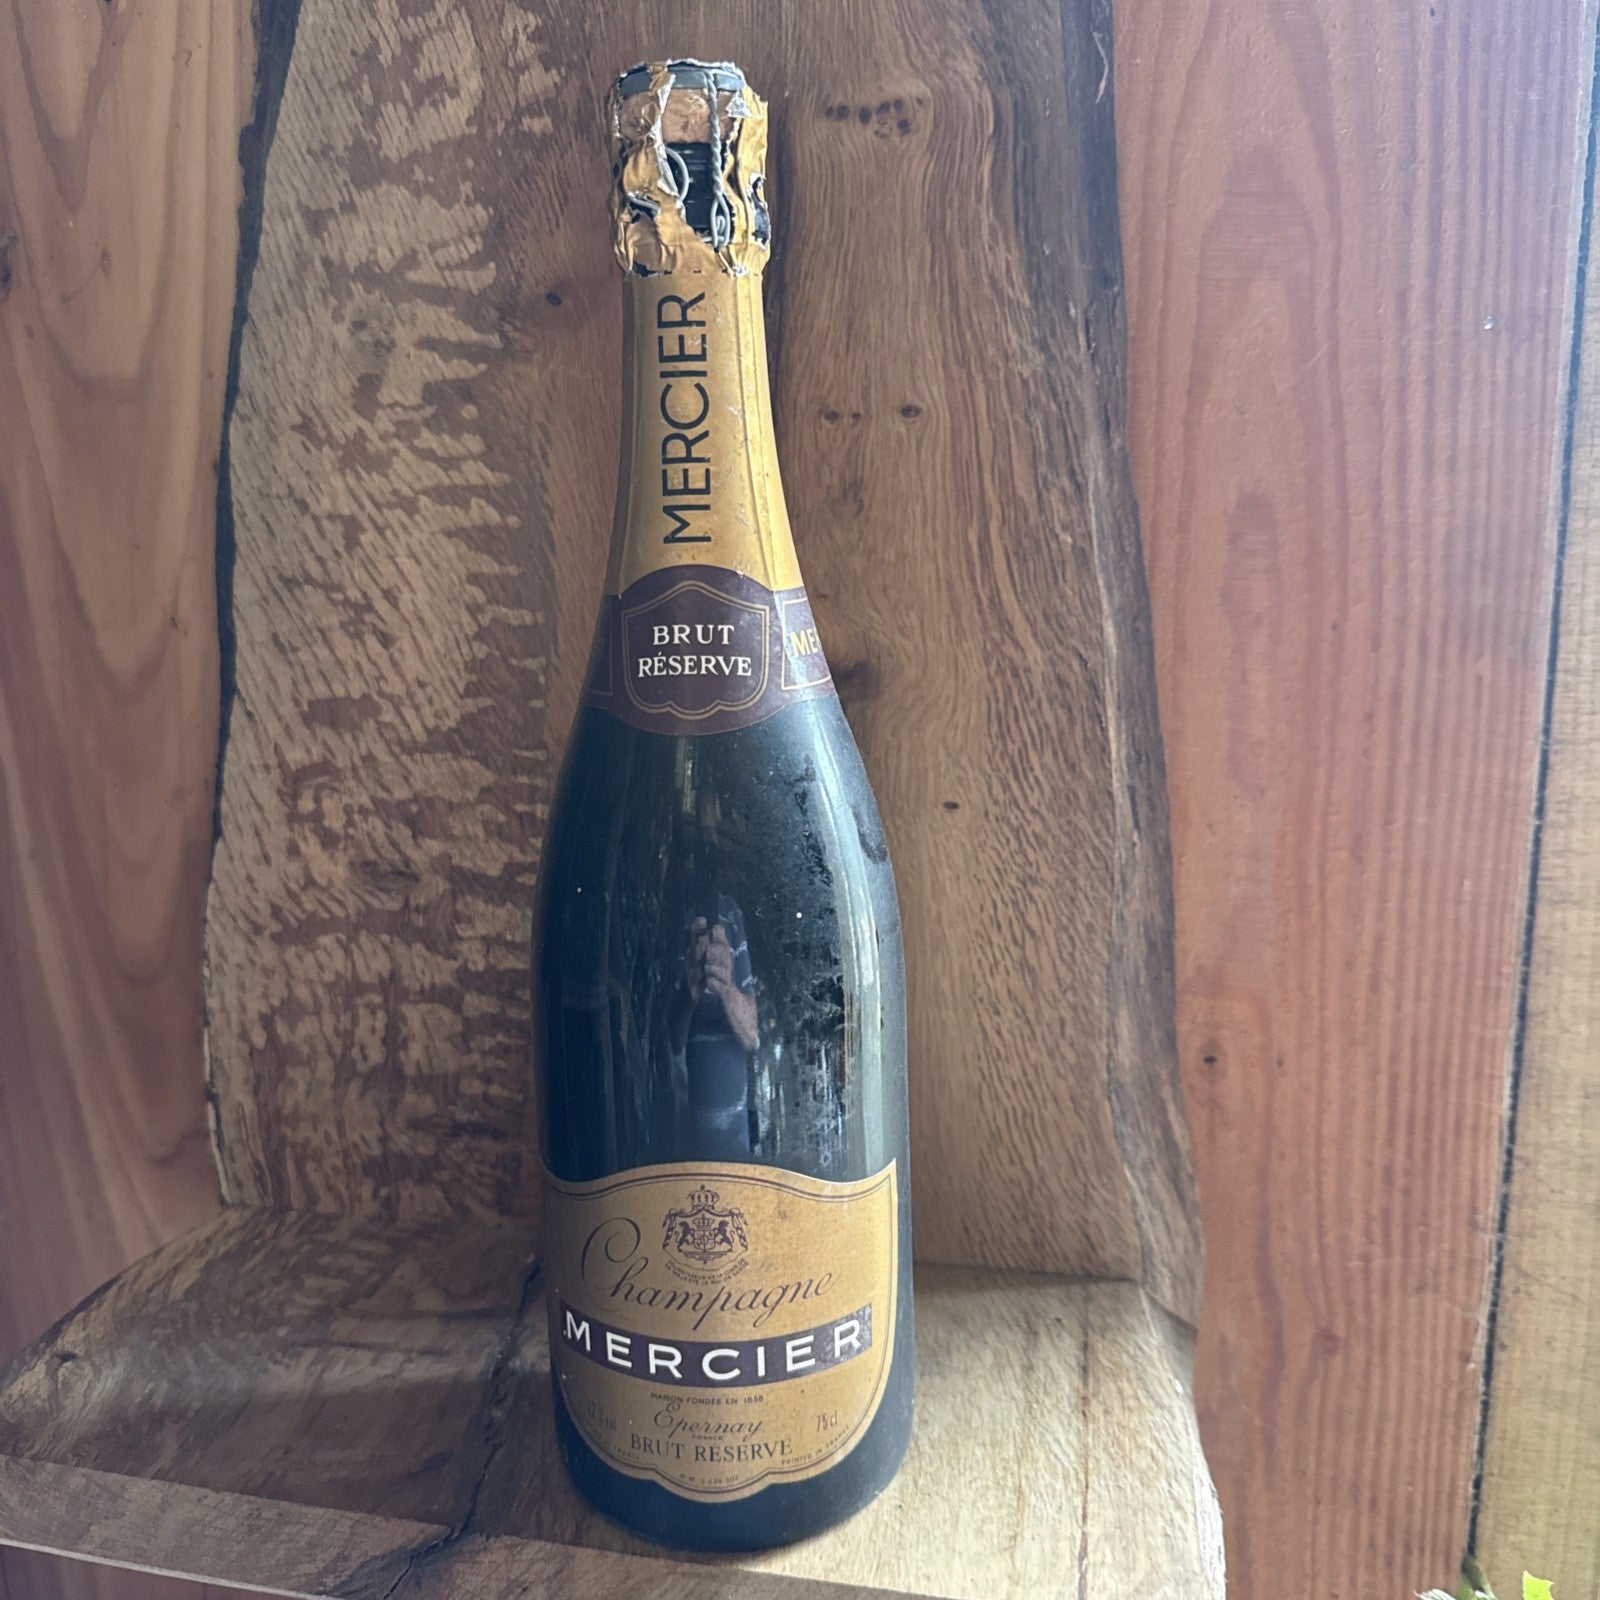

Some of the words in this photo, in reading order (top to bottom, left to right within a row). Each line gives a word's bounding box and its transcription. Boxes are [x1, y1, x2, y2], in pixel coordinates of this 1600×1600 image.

[657, 292, 712, 544] MERCIER
[653, 624, 735, 646] BRUT
[637, 651, 752, 678] RÉSERVE
[581, 1217, 840, 1331] Champagne
[565, 1310, 863, 1381] MERCIER
[650, 1392, 683, 1404] MAISON
[725, 1397, 738, 1405] EN
[630, 1433, 685, 1459] BRUT
[781, 1452, 813, 1466] PRINTED
